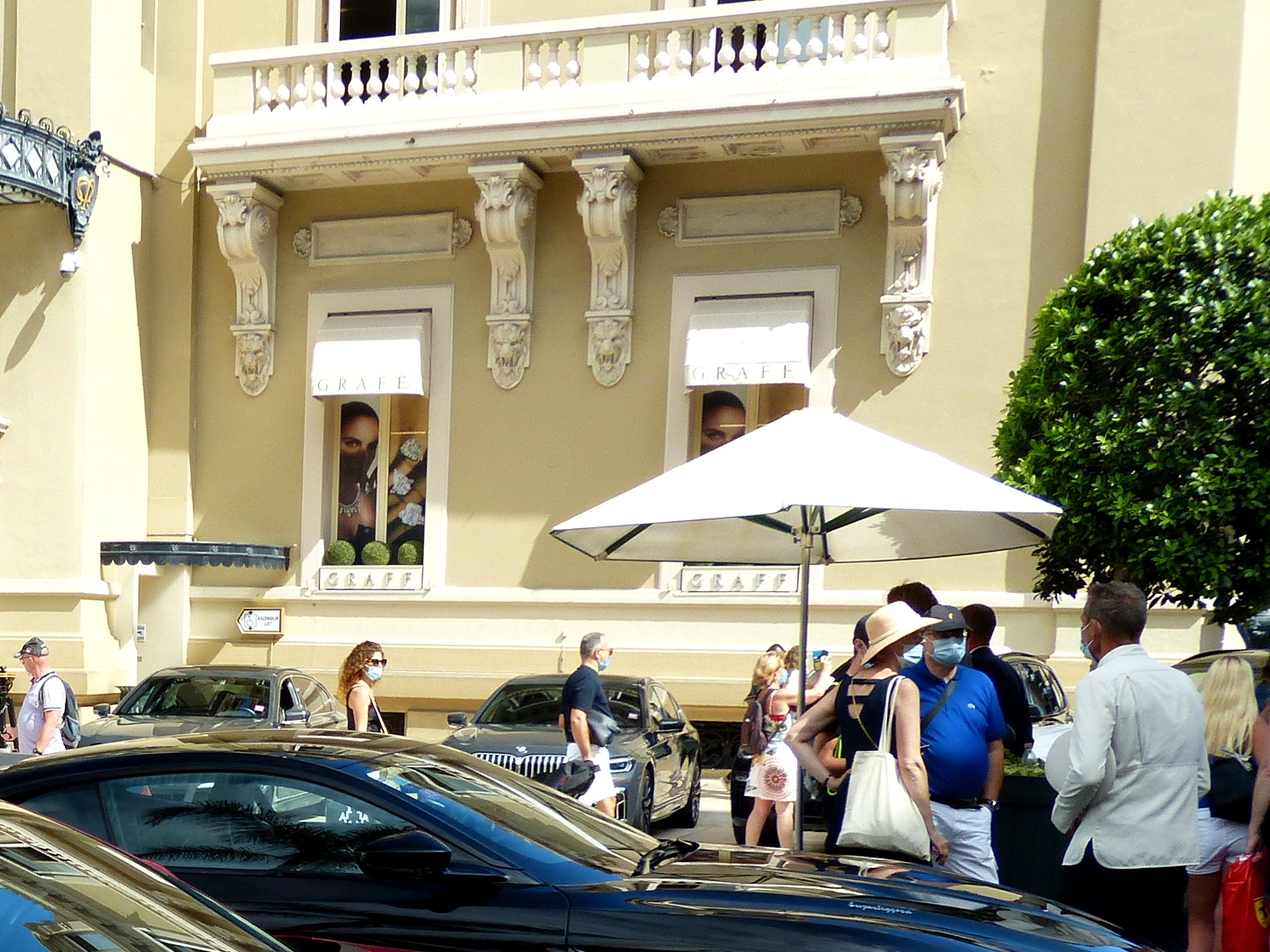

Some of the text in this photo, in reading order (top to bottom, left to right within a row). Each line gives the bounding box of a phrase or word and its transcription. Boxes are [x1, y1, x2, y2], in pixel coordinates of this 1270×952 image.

[692, 364, 795, 381] GRAFF
[317, 376, 409, 392] GRAFF
[326, 572, 413, 587] GRAFF
[689, 573, 787, 590] GRAFF
